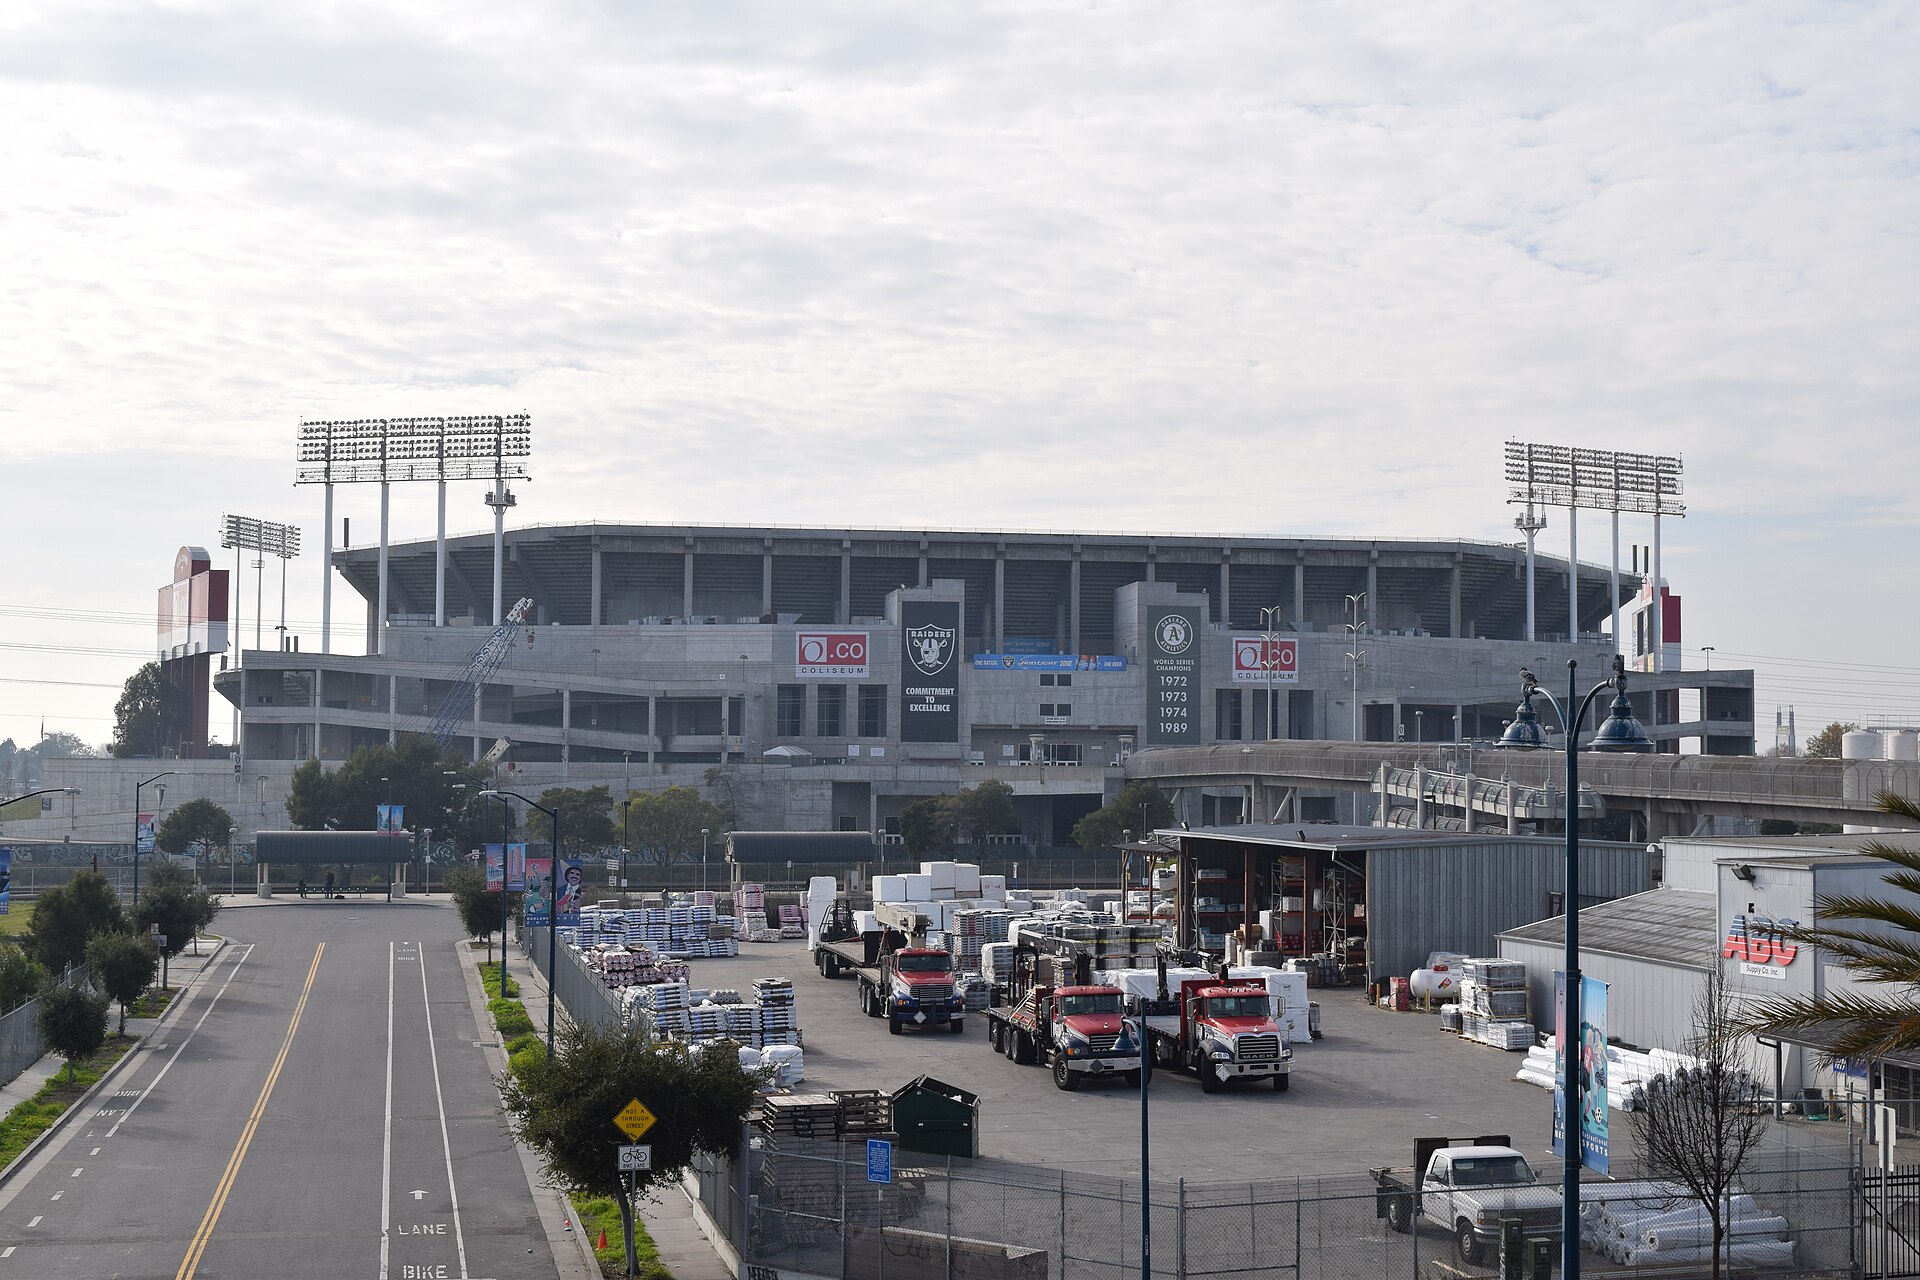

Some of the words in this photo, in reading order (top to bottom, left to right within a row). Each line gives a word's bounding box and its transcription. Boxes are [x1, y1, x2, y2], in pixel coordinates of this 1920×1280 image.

[1161, 616, 1187, 629] OAKLAND
[1160, 639, 1188, 652] ATHLETICS
[1160, 676, 1188, 687] 1972
[905, 687, 955, 696] COMMITMENT
[1160, 691, 1188, 702] 1973
[925, 696, 935, 704] TO
[909, 703, 951, 712] EXCELLENCE
[1160, 707, 1188, 718] 1974
[1159, 722, 1188, 733] 1989
[1723, 914, 1800, 966] ABC
[1746, 964, 1761, 975] Supply
[1582, 1138, 1608, 1157] SPORTS
[398, 1224, 447, 1236] LANE
[403, 1264, 448, 1279] BIKE
